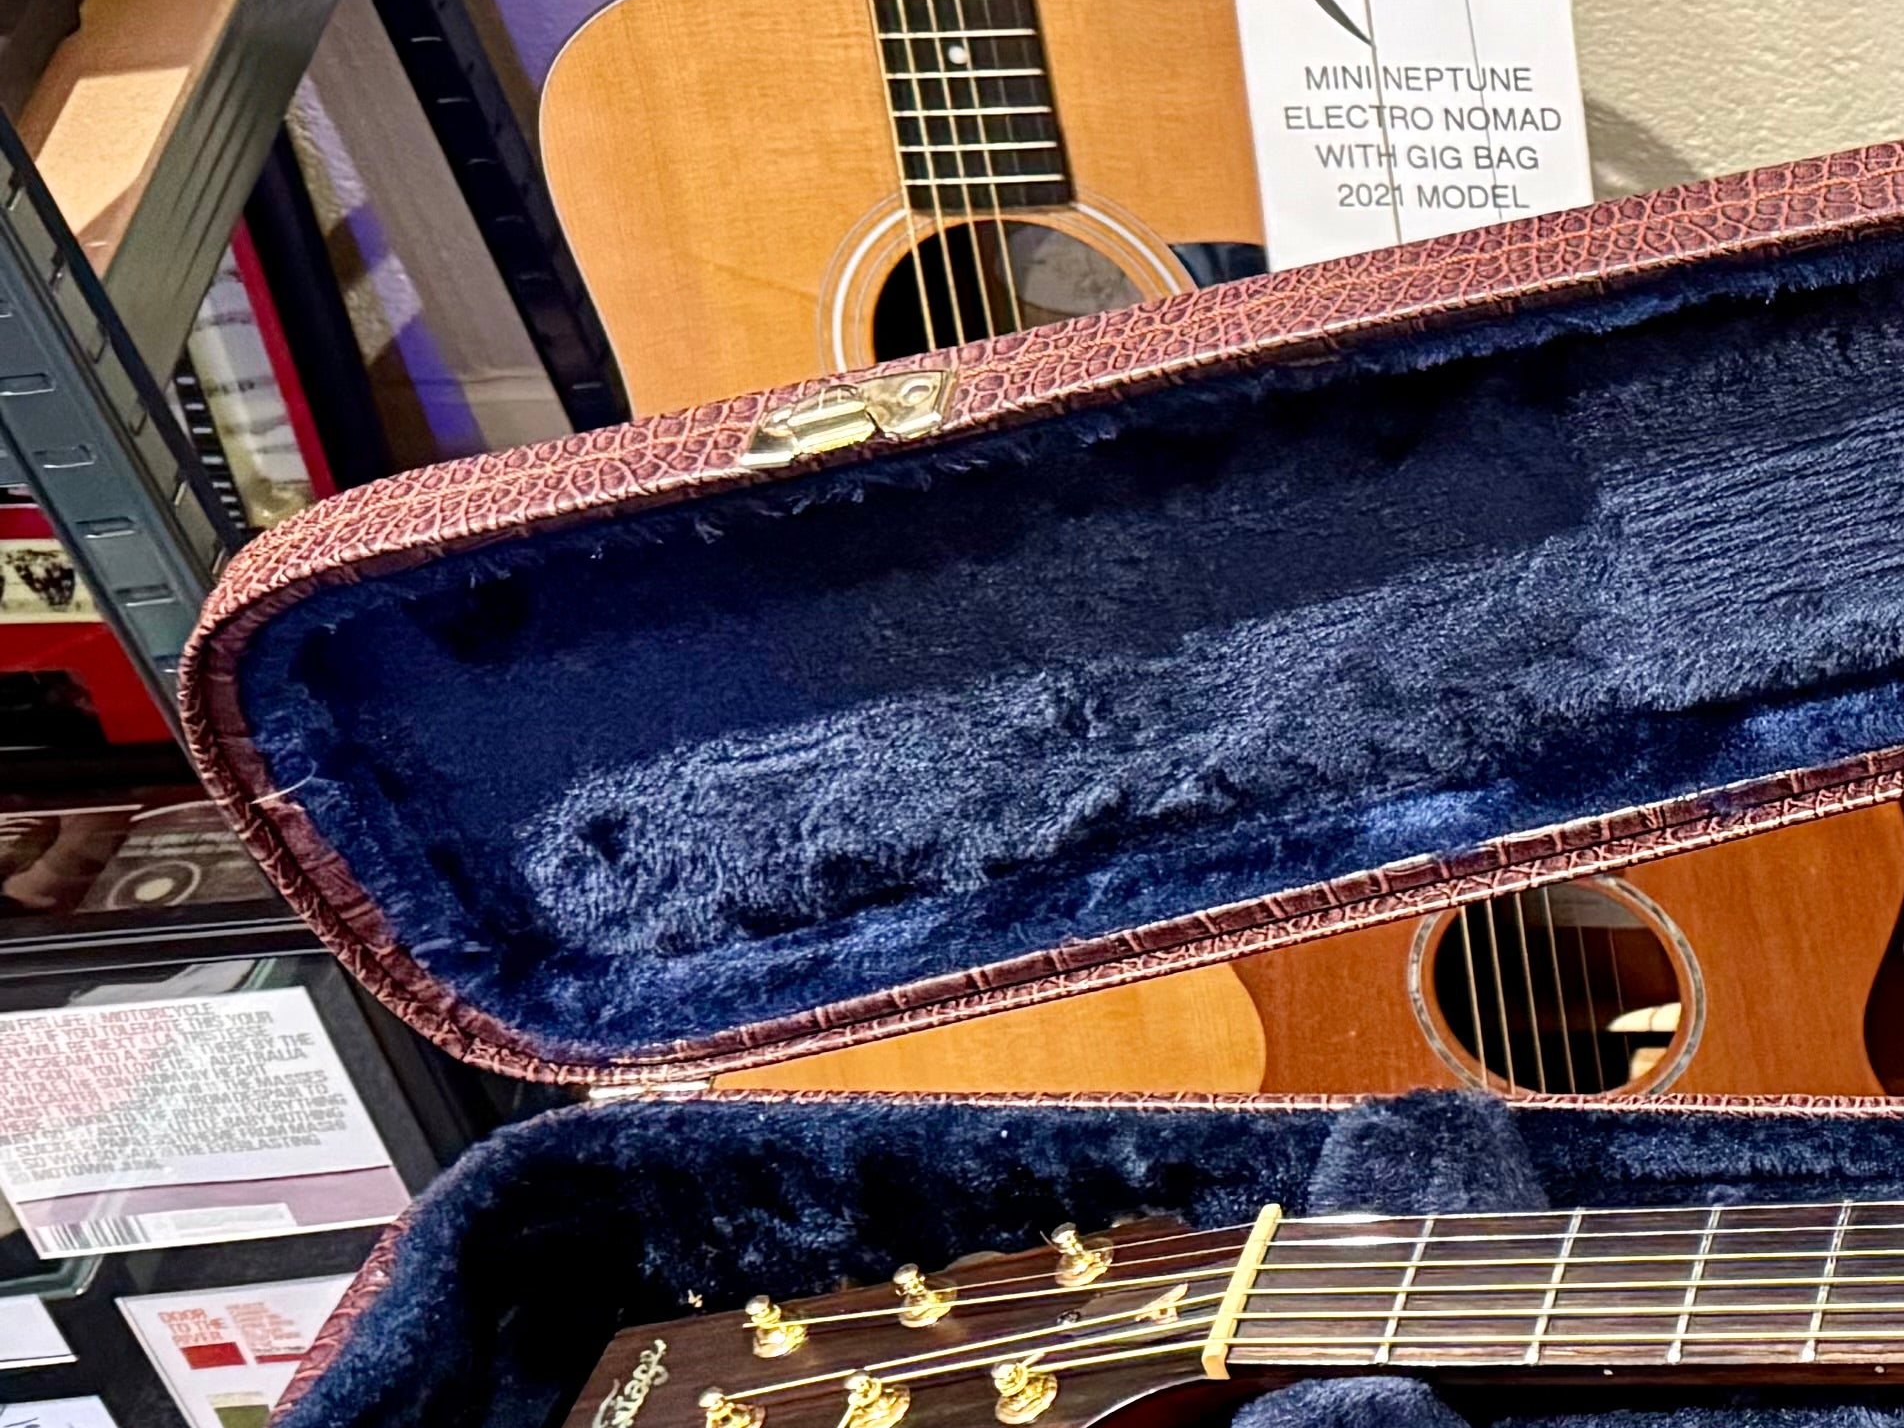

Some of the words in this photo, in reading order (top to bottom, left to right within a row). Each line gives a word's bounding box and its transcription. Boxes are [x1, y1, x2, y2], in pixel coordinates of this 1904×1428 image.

[1304, 66, 1374, 92] MINI
[1382, 67, 1534, 93] NEPTUNE
[1284, 105, 1434, 131] ELECTRO
[1443, 107, 1562, 132] NOMAD
[1315, 144, 1398, 169] WITH
[1406, 145, 1463, 170] GIG
[1475, 146, 1540, 170] BAG
[1337, 184, 1405, 208] 2021
[1416, 184, 1531, 209] MODEL
[97, 1002, 215, 1023] MOTORCYCLE
[98, 1018, 185, 1037] TOLERATE
[224, 1009, 274, 1026] YOUR
[204, 1047, 309, 1068] AUSTRALIA
